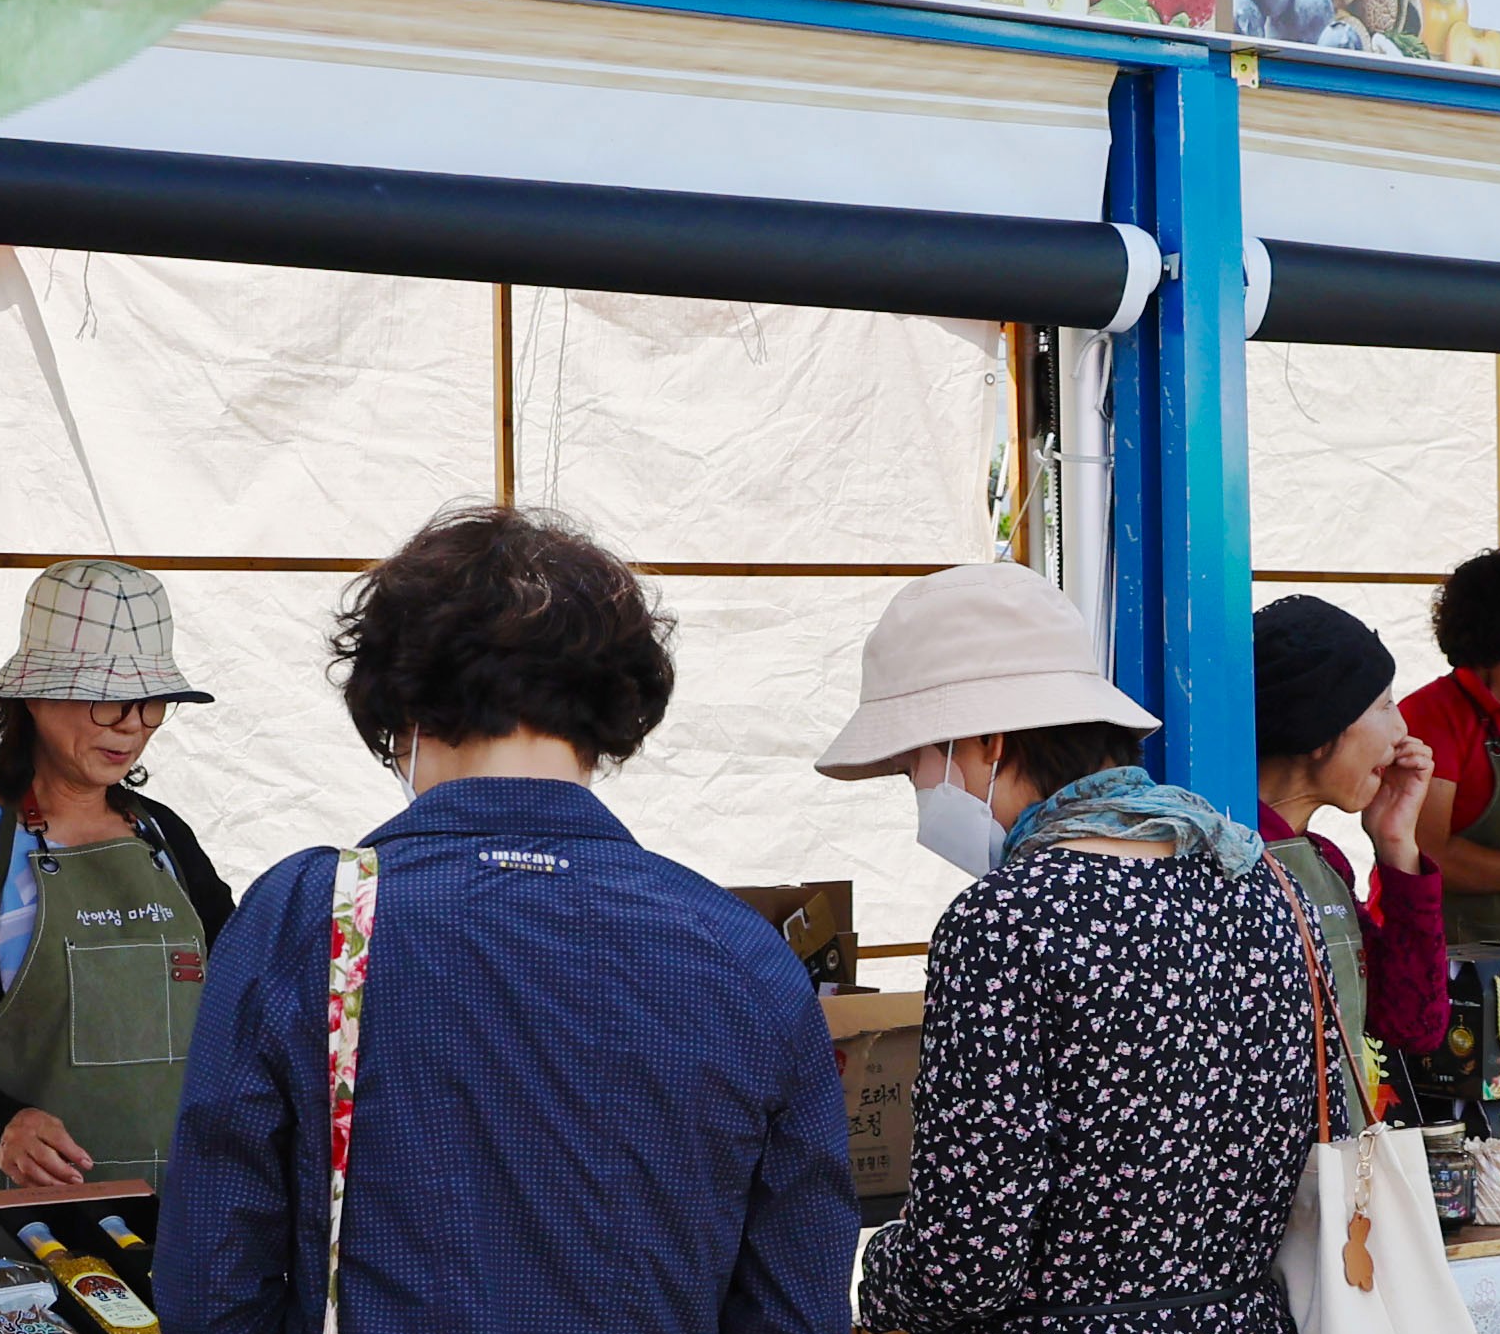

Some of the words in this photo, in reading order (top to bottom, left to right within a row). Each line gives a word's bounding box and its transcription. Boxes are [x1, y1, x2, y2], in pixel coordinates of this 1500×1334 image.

[491, 850, 557, 866] macaw
[76, 909, 122, 927] 산엔청
[860, 1082, 901, 1107] 도라지
